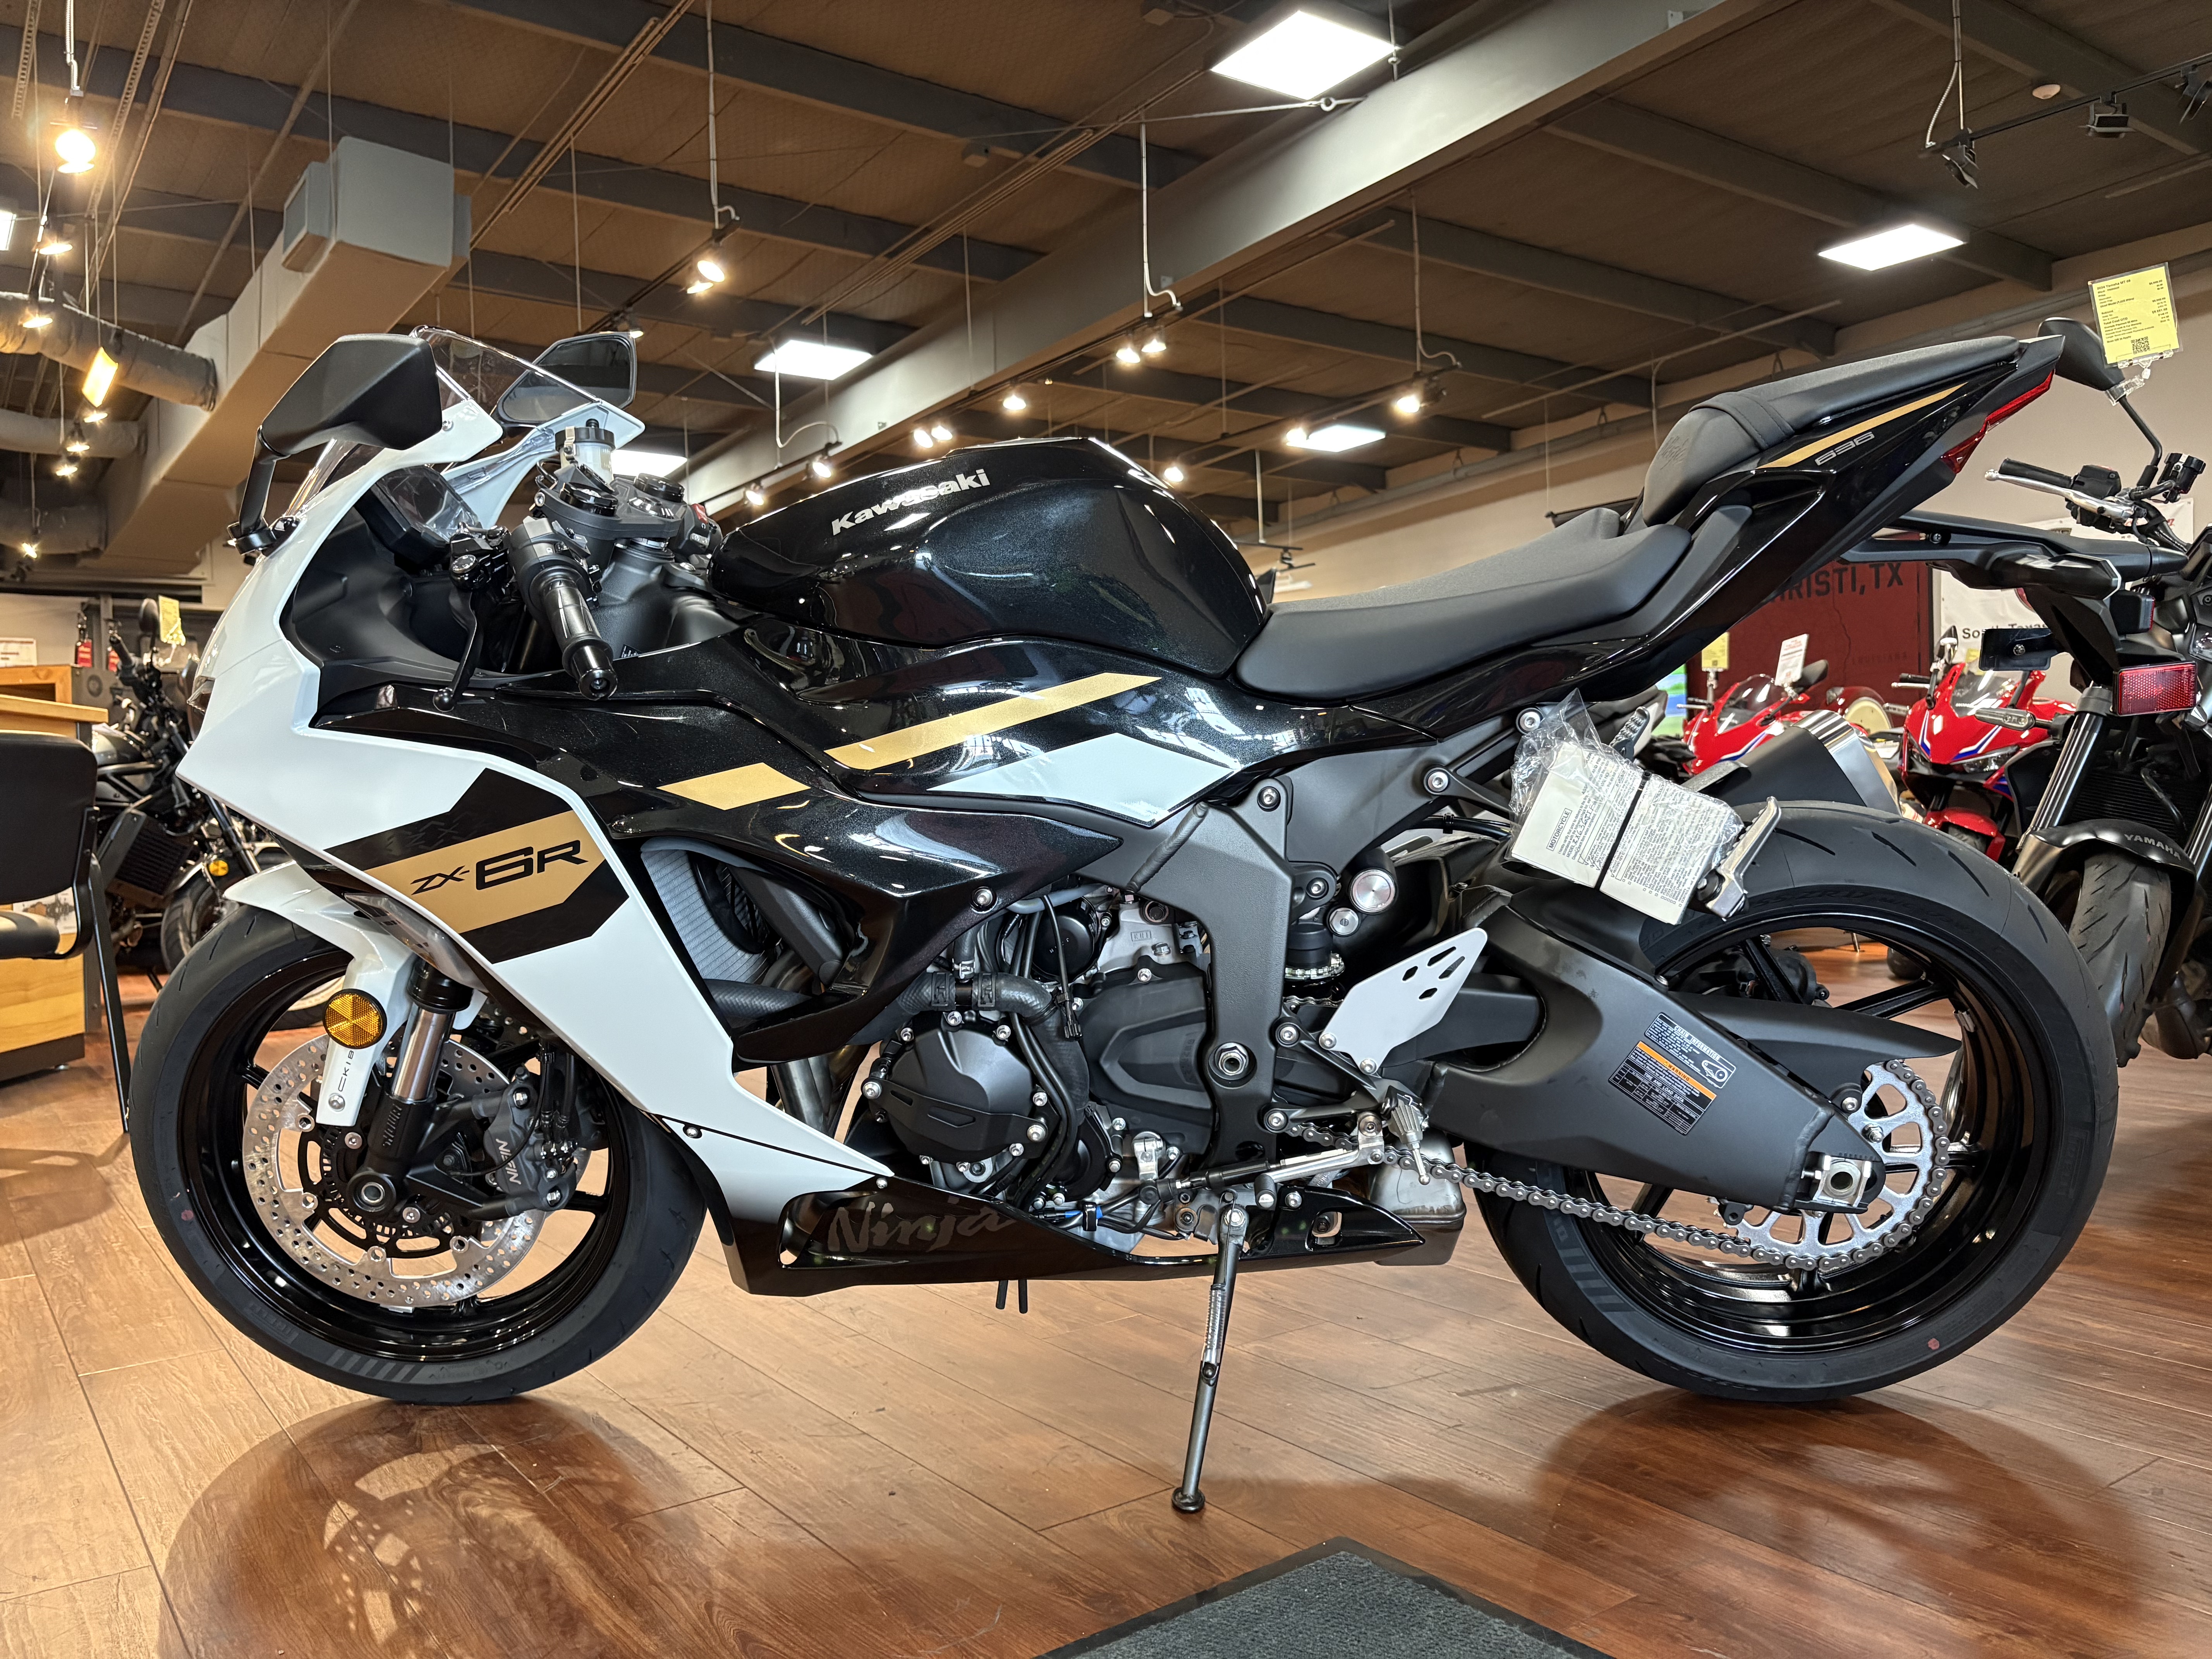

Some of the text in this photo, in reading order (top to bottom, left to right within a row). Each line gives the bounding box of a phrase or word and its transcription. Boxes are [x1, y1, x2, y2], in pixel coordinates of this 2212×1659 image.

[831, 469, 990, 536] Kawasaki
[1548, 810, 1570, 848] MOTORCYCLE
[2124, 834, 2181, 860] YAMAHA
[1673, 1025, 1720, 1061] CHAIN INFORMATION
[1643, 1072, 1685, 1103] TIRE AND LOAD DATA
[1668, 1064, 1690, 1081] WARNING
[828, 1201, 1016, 1253] Ninja
